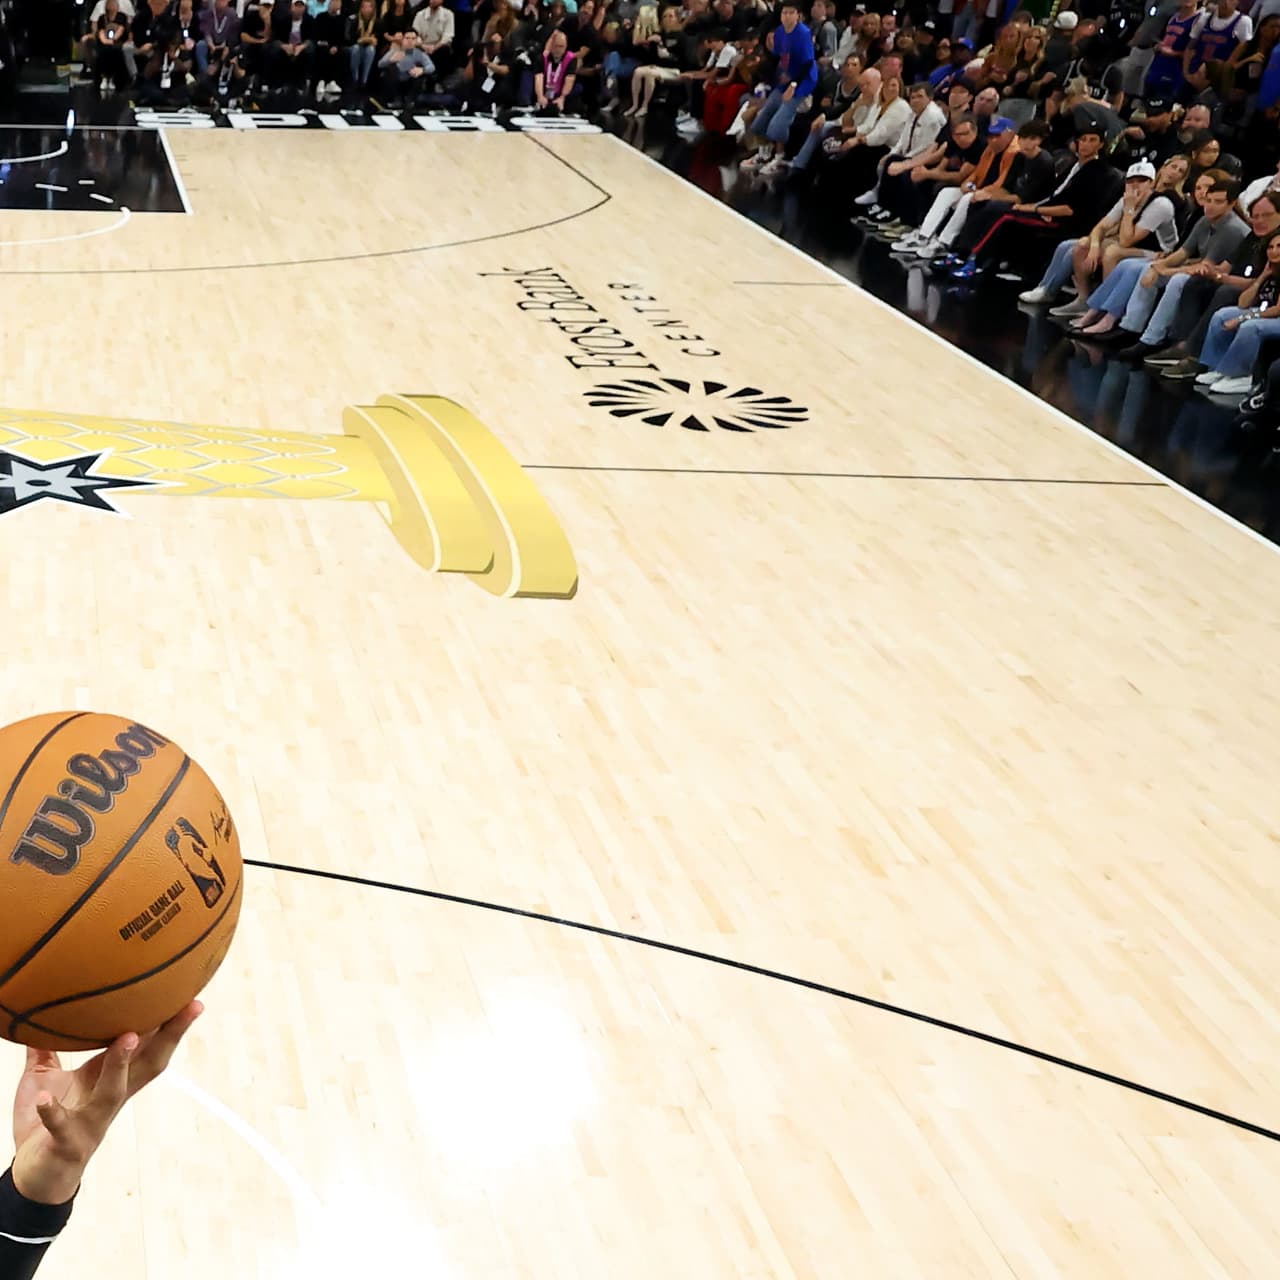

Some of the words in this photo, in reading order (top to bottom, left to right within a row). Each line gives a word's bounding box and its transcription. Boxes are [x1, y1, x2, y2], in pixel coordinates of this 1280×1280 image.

[135, 112, 603, 133] SPURS
[477, 267, 597, 312] Bank
[538, 317, 661, 371] Frost
[607, 283, 721, 357] CENTER
[8, 722, 172, 876] Wilson
